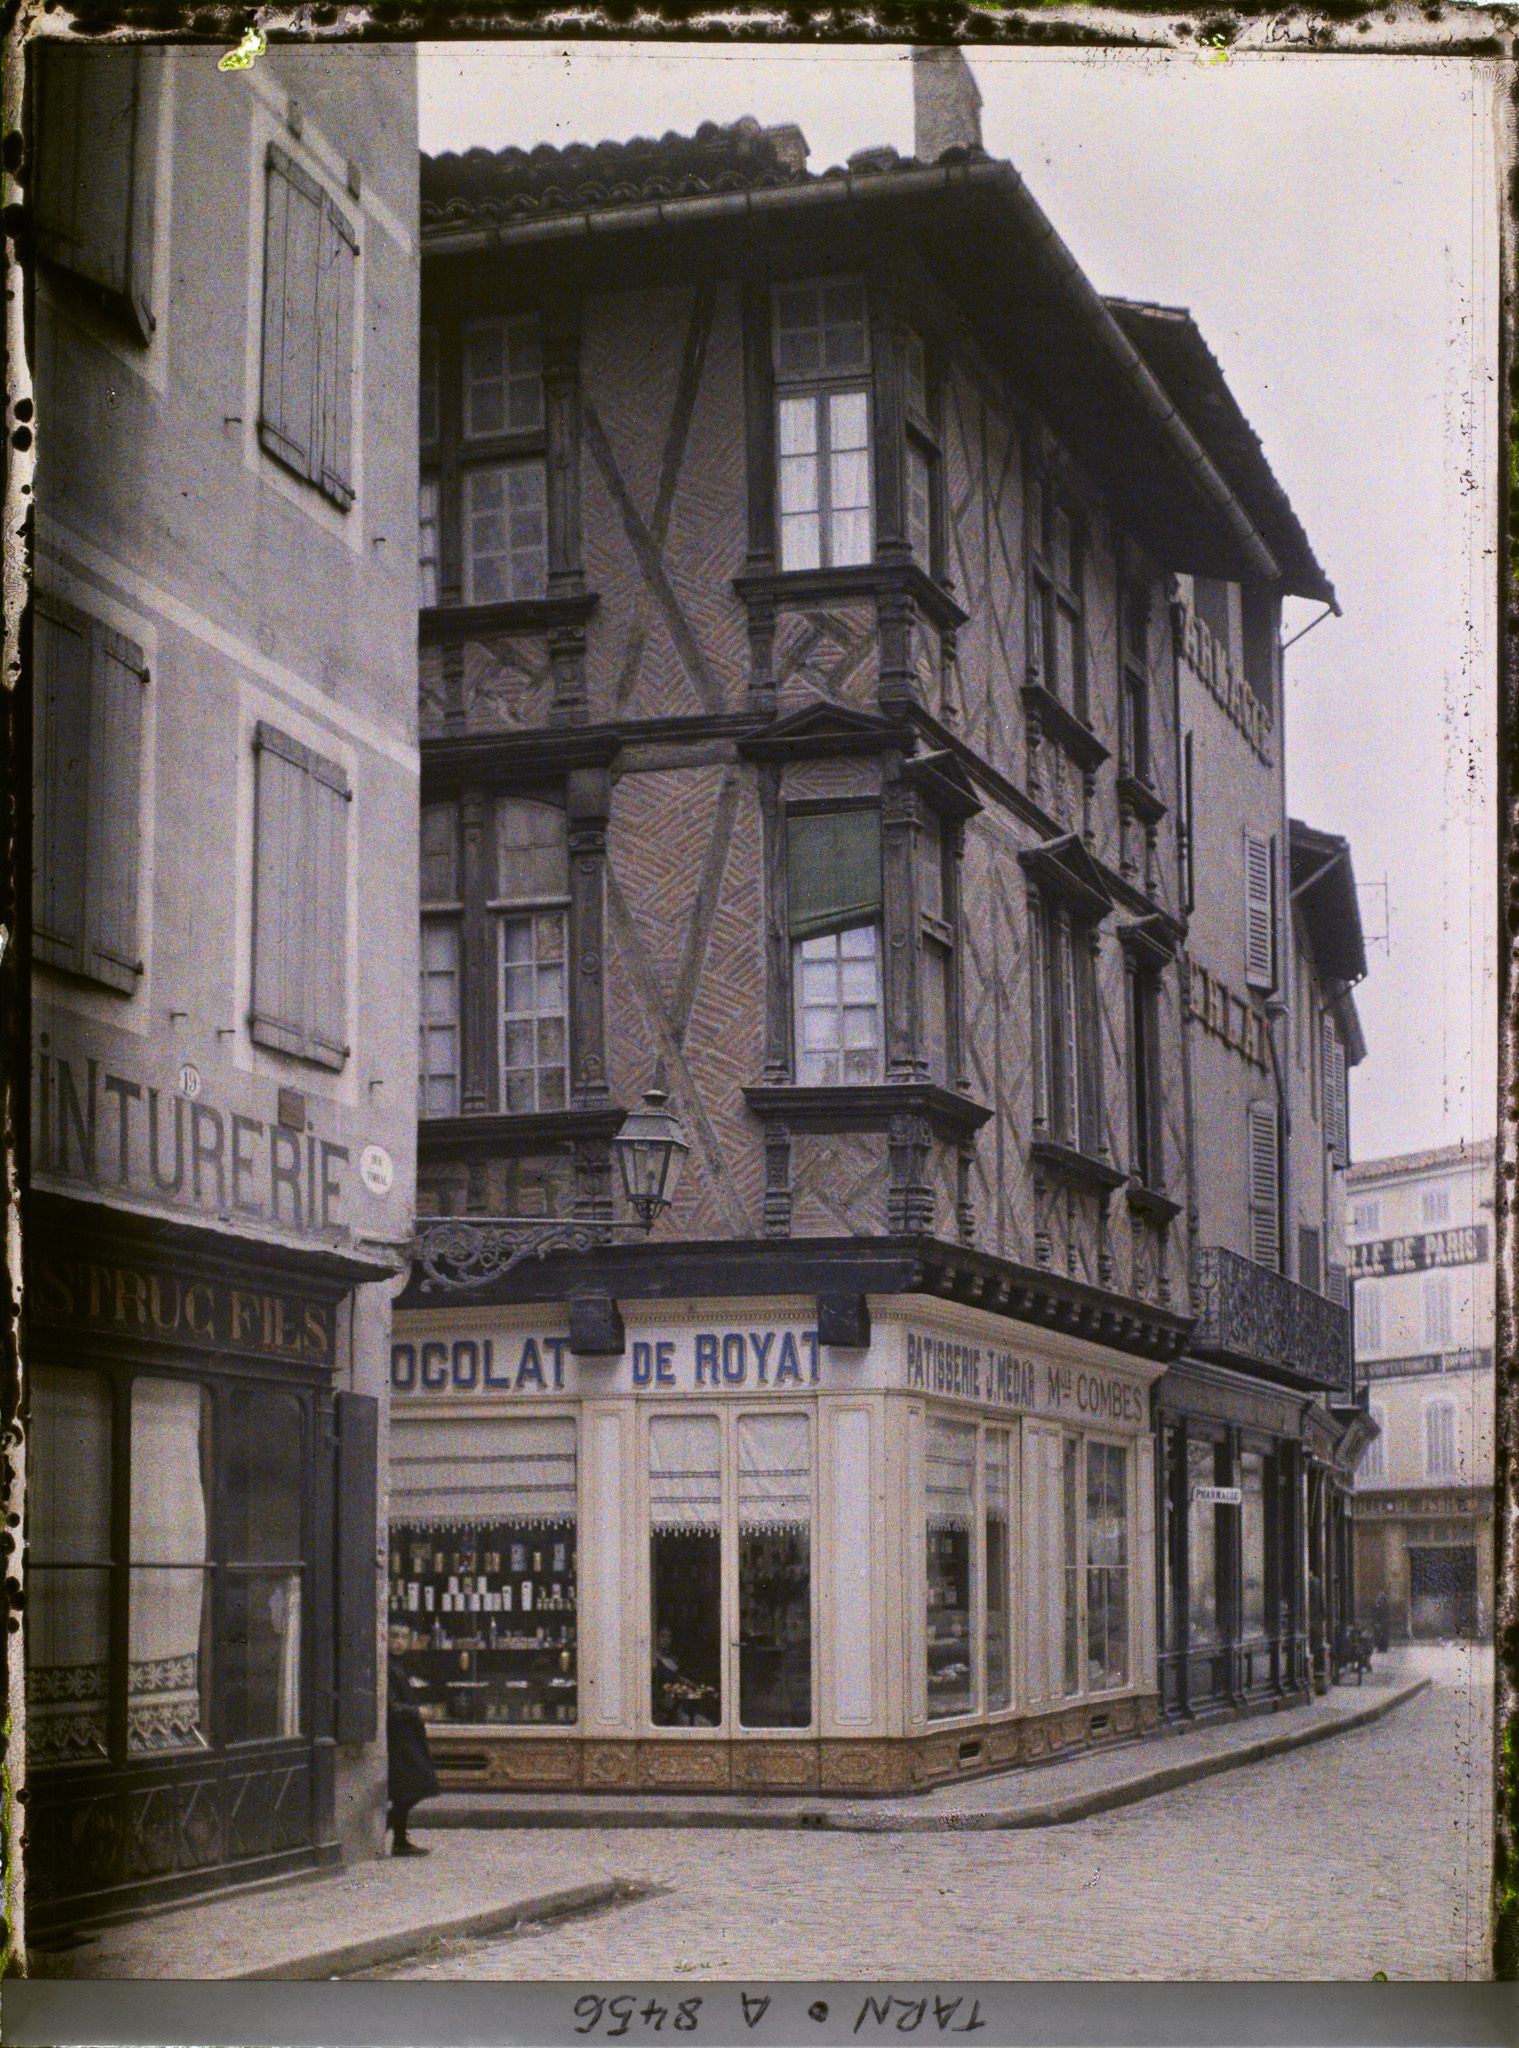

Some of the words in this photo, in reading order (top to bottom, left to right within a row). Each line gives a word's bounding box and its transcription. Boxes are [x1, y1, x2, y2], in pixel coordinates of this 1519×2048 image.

[1392, 1236, 1417, 1271] DE
[1425, 1227, 1478, 1268] PARIS
[229, 1289, 329, 1358] FILS
[632, 1341, 676, 1385] DE
[695, 1330, 821, 1388] ROYAT
[906, 1331, 980, 1397] PATISSERIE
[1077, 1373, 1143, 1422] COMBES
[1196, 1488, 1239, 1501] PHARMACIE
[573, 1993, 703, 2037] 8456
[741, 1992, 772, 2029] A
[853, 1995, 987, 2033] TARN
